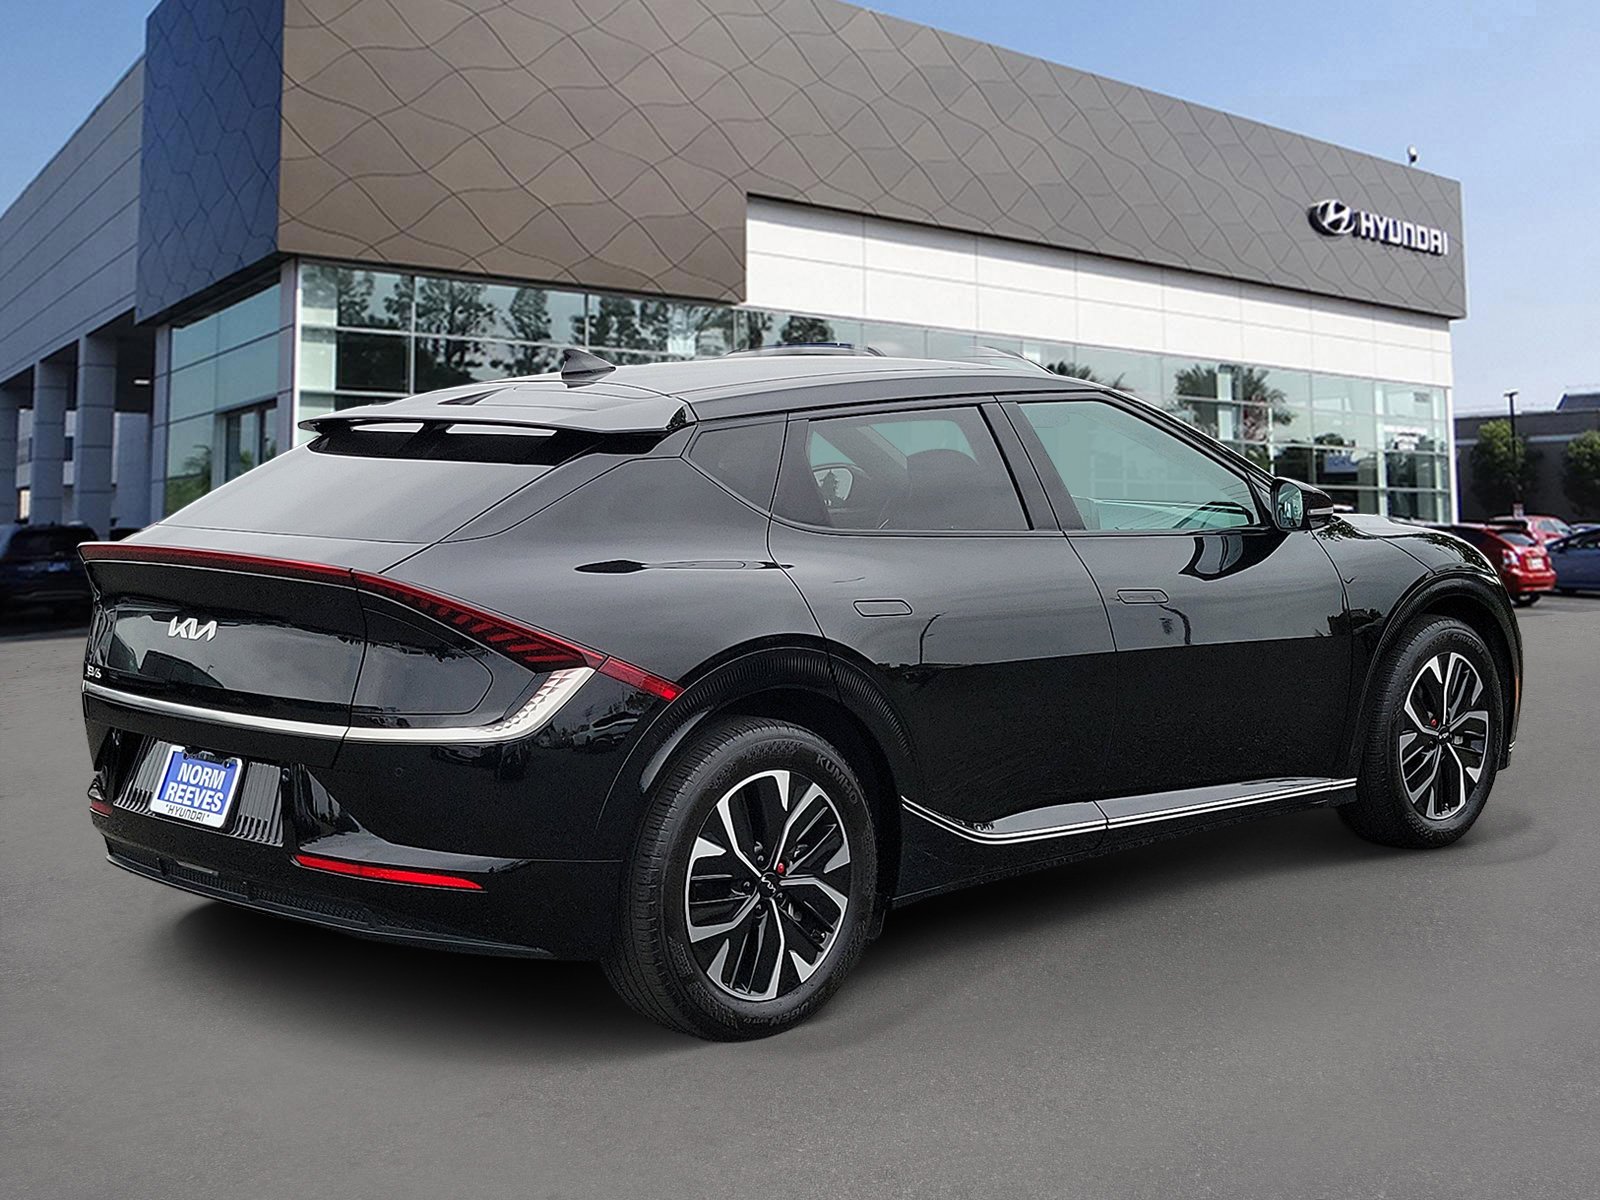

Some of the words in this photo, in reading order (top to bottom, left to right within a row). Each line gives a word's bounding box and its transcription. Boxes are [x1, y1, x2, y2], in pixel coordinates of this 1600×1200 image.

[1360, 210, 1449, 255] HYUNDAI
[177, 762, 226, 790] NORM
[164, 782, 224, 812] REEVES
